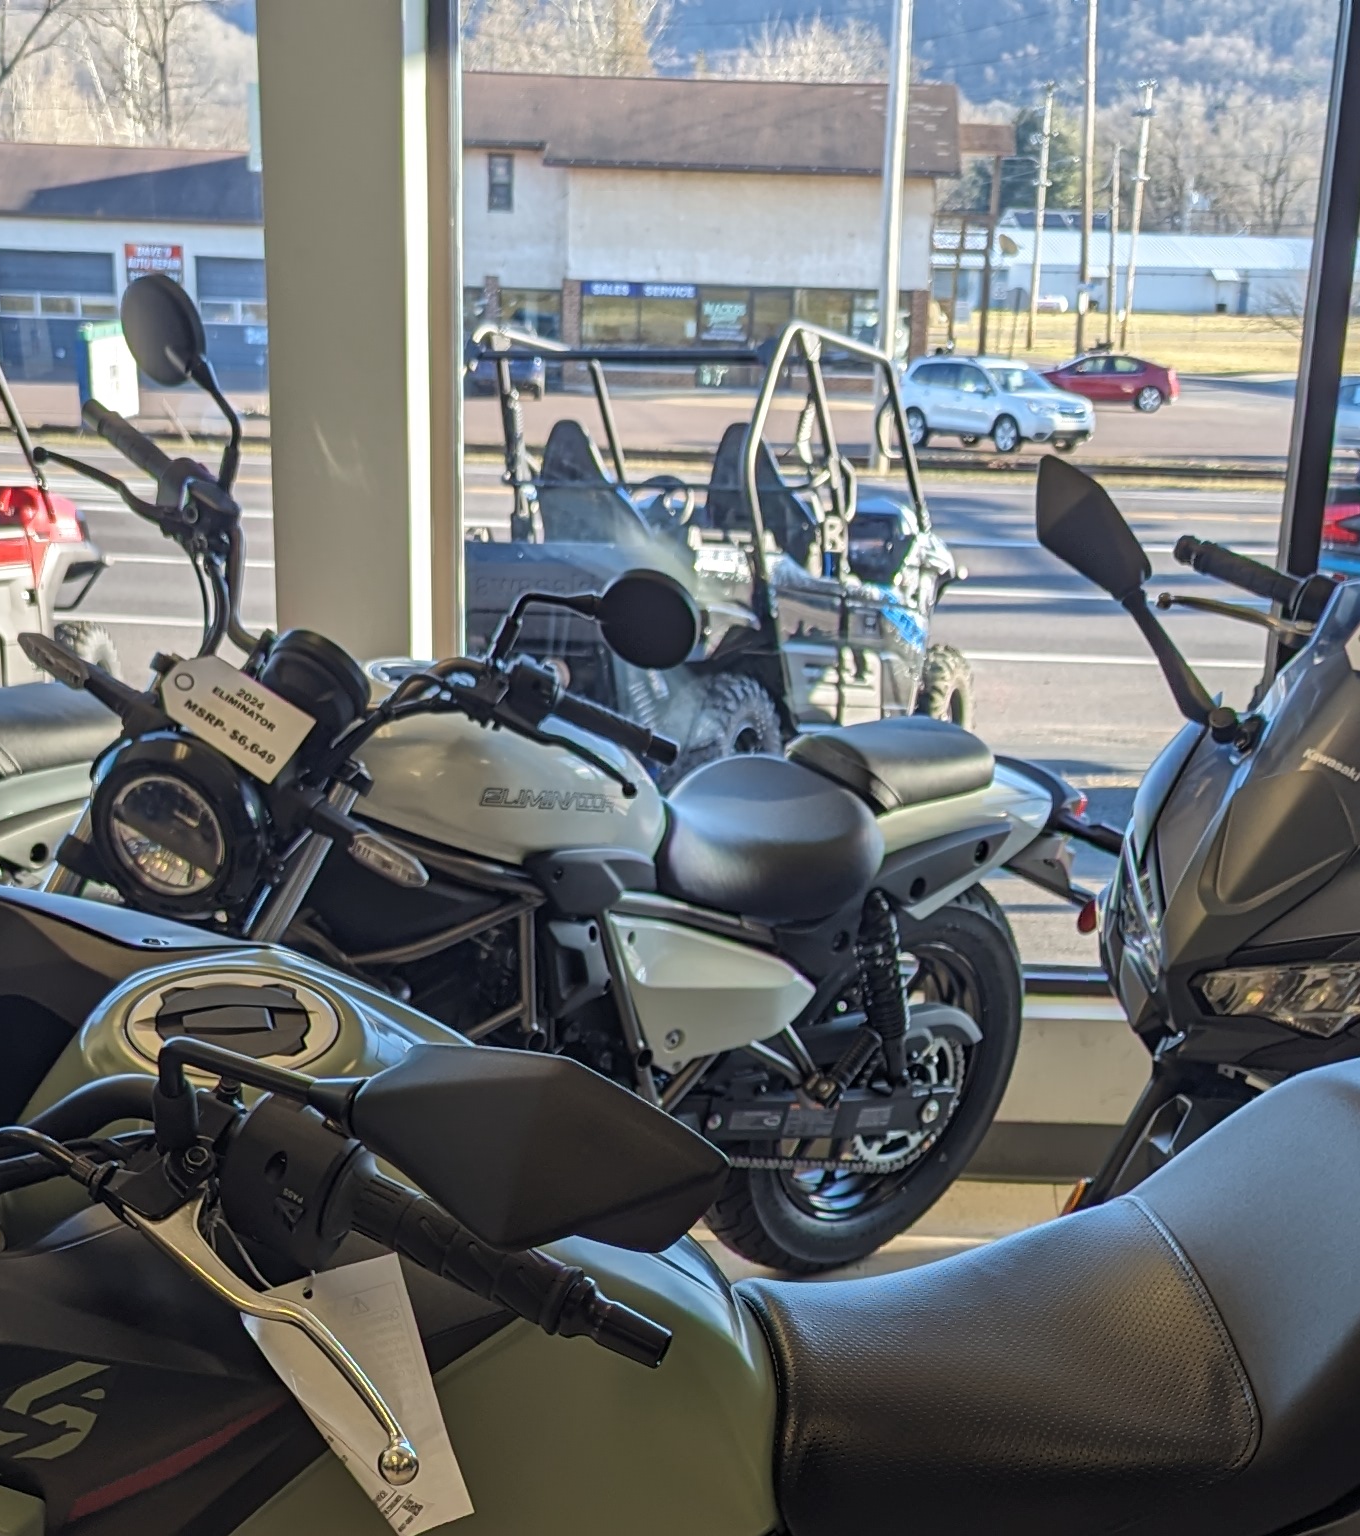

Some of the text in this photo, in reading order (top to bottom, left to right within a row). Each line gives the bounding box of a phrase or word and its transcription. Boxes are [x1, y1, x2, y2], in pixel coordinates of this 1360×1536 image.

[591, 284, 631, 296] SALES
[643, 286, 696, 298] SERVICE
[212, 686, 276, 733] ELIMINATOR
[235, 688, 266, 711] 2024
[229, 729, 277, 765] $6,649
[478, 787, 615, 813] ELIMINATOR
[283, 1187, 304, 1204] PASS
